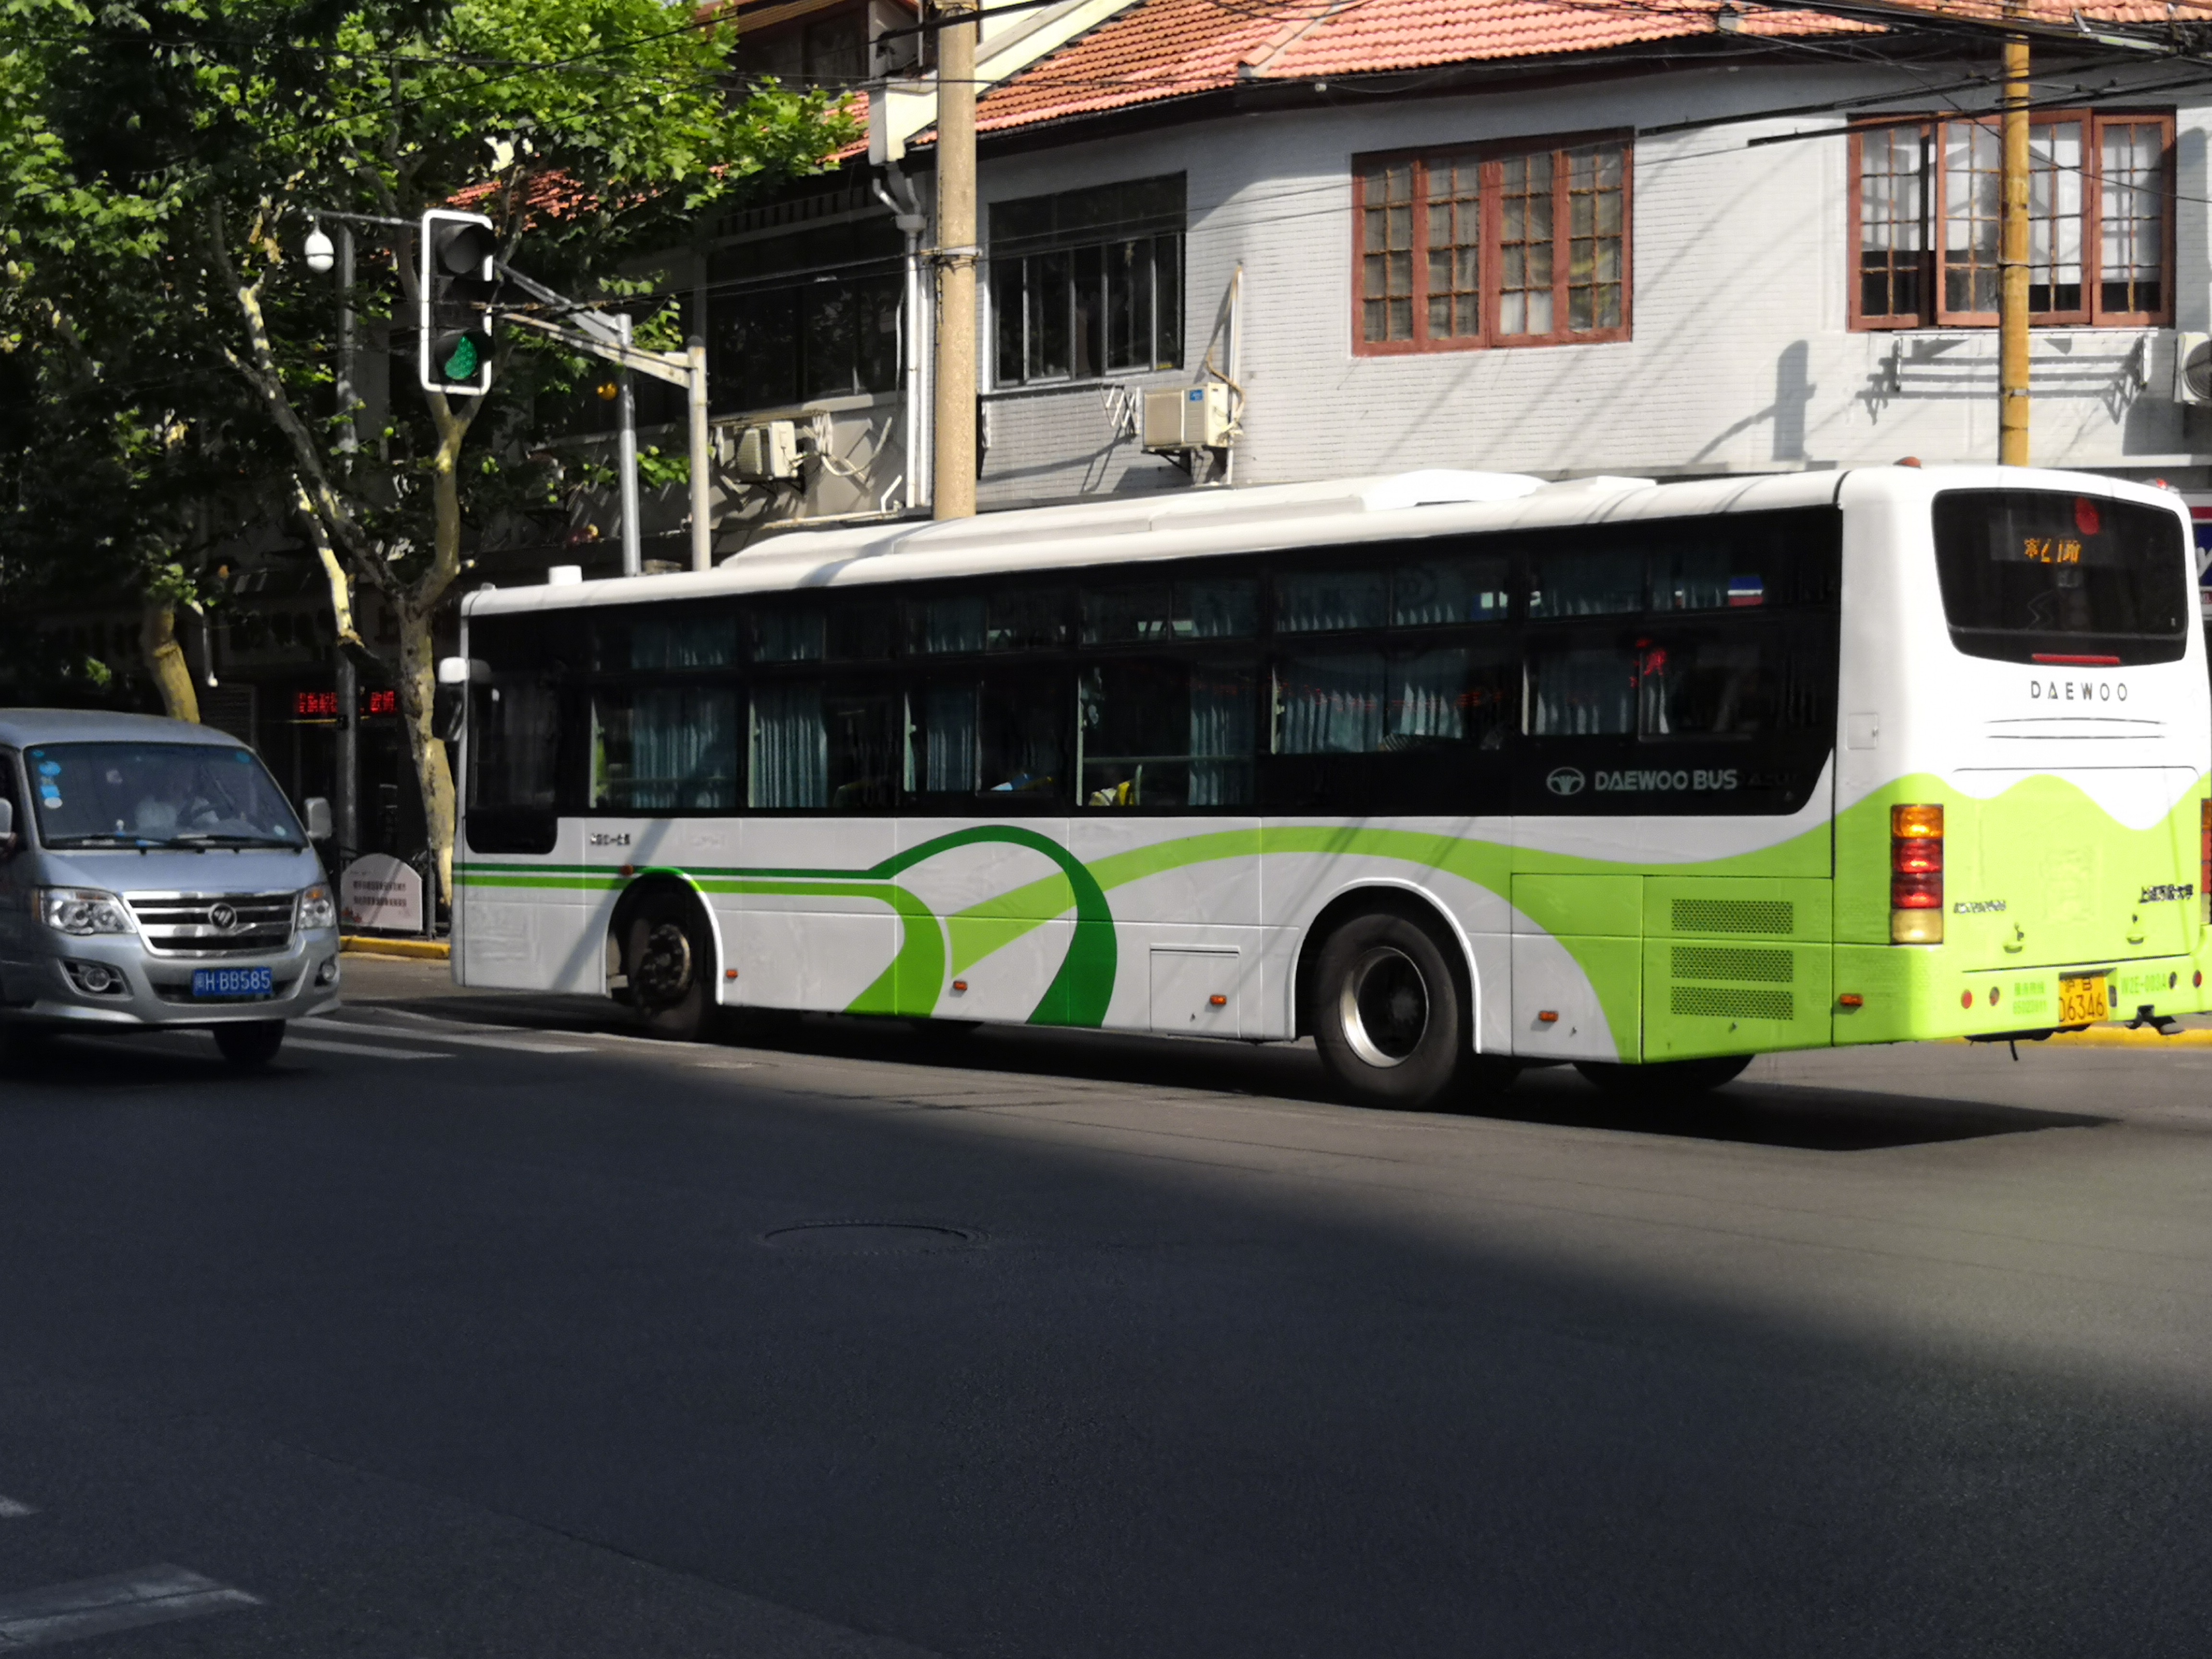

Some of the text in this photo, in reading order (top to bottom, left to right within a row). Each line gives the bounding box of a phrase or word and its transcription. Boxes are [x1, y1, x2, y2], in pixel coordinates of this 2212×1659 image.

[2031, 680, 2128, 701] DAEWOO
[1594, 770, 1688, 791] DAEWOO
[1693, 769, 1737, 790] BUS
